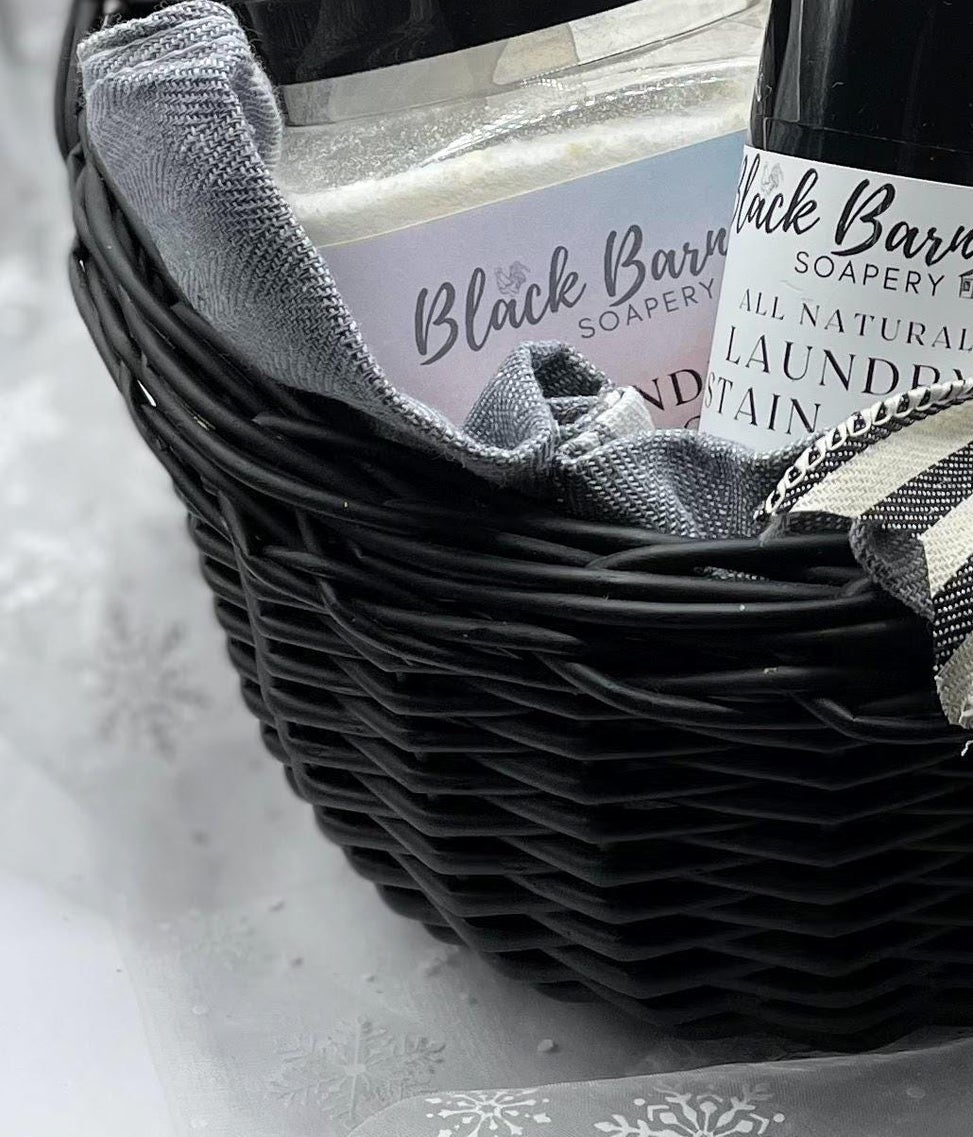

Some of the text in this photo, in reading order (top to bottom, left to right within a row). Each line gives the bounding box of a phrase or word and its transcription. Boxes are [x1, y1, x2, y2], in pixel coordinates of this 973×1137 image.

[731, 153, 820, 235] lack
[414, 224, 728, 365] Black Barn
[794, 251, 945, 297] SOAPERY
[578, 278, 716, 339] SOAPERY
[739, 289, 973, 351] ALL NATURAL
[704, 371, 822, 434] STAIN
